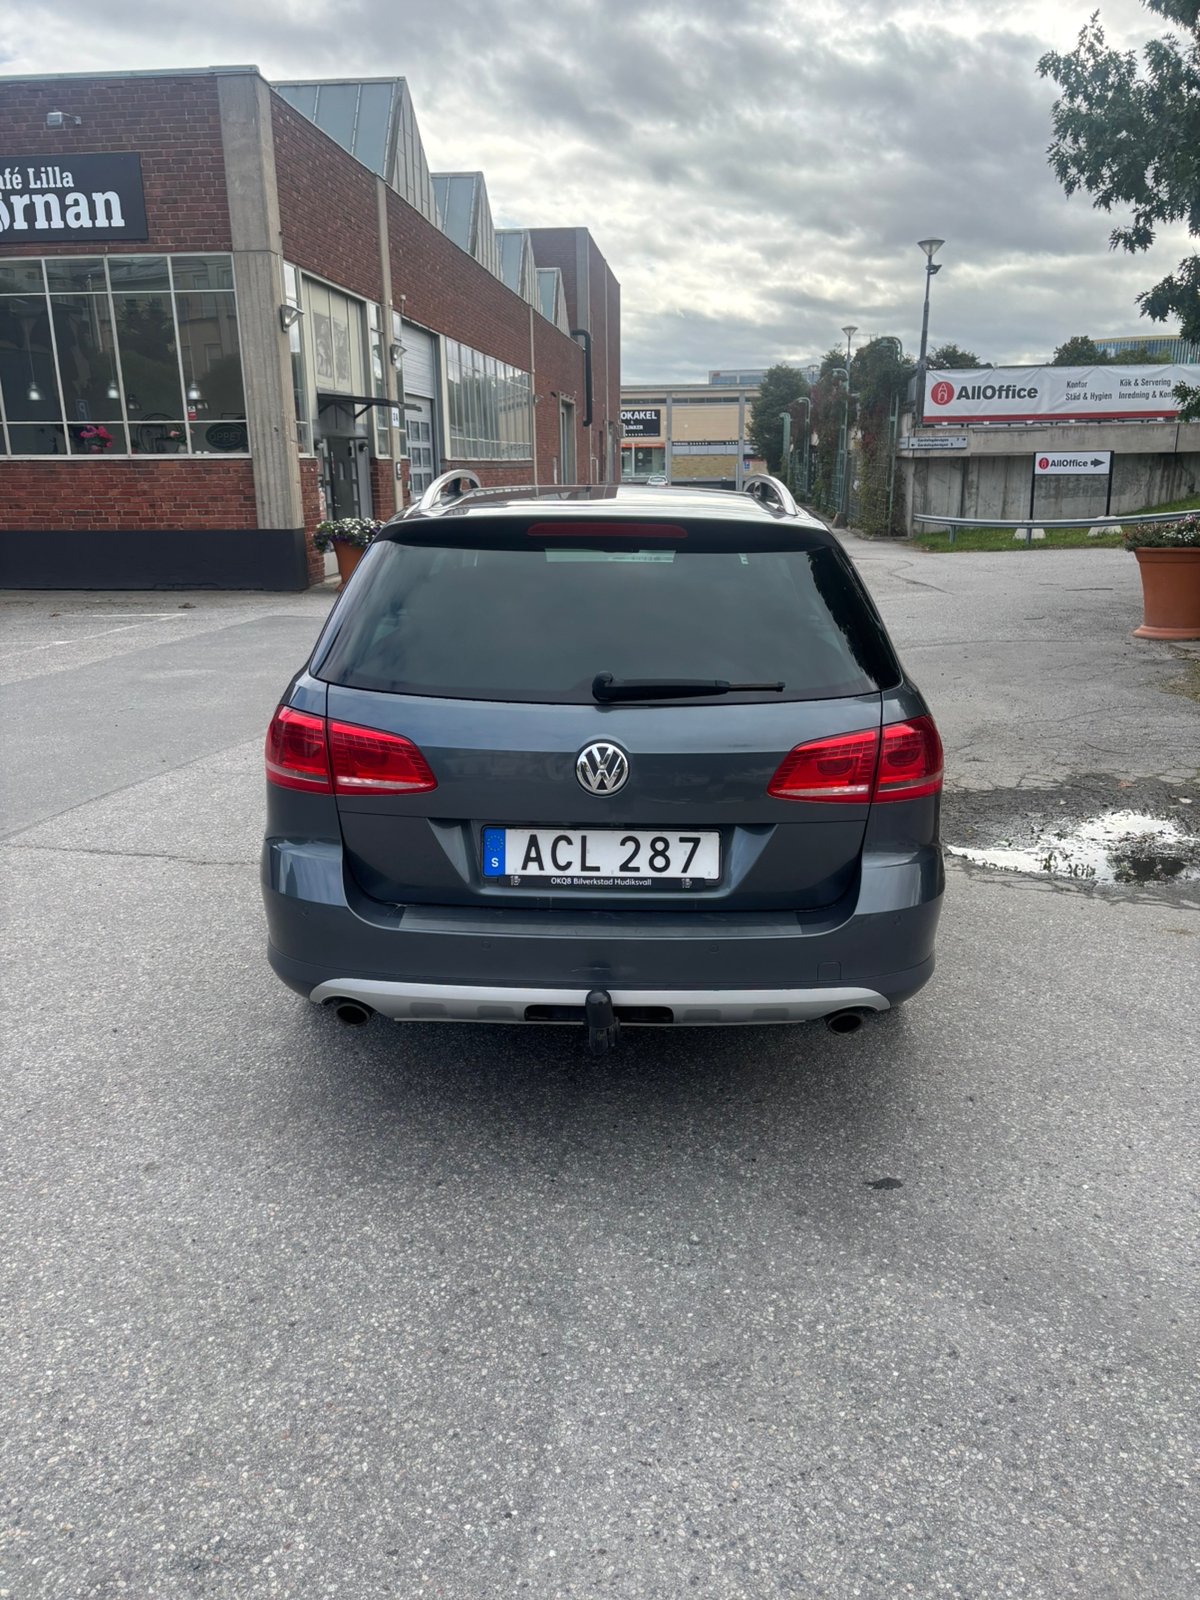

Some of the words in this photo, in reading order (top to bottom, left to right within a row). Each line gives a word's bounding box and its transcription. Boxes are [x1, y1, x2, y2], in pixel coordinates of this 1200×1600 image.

[27, 166, 74, 188] Lilla
[1066, 381, 1087, 389] Kontor
[1120, 379, 1132, 387] Kök
[1133, 379, 1139, 387] &
[1140, 378, 1171, 387] Servering
[956, 385, 1038, 400] AllOffice
[1065, 392, 1081, 401] Städ
[1082, 392, 1088, 400] &
[1090, 392, 1112, 401] Hygien
[1118, 391, 1149, 400] Inredning
[1050, 459, 1088, 467] AllOffice
[521, 834, 601, 872] ACL
[619, 835, 702, 874] 287
[491, 857, 499, 868] S
[551, 877, 572, 886] OKQ8
[573, 877, 613, 885] Bilverkstad
[615, 878, 652, 886] Hudiksvall
